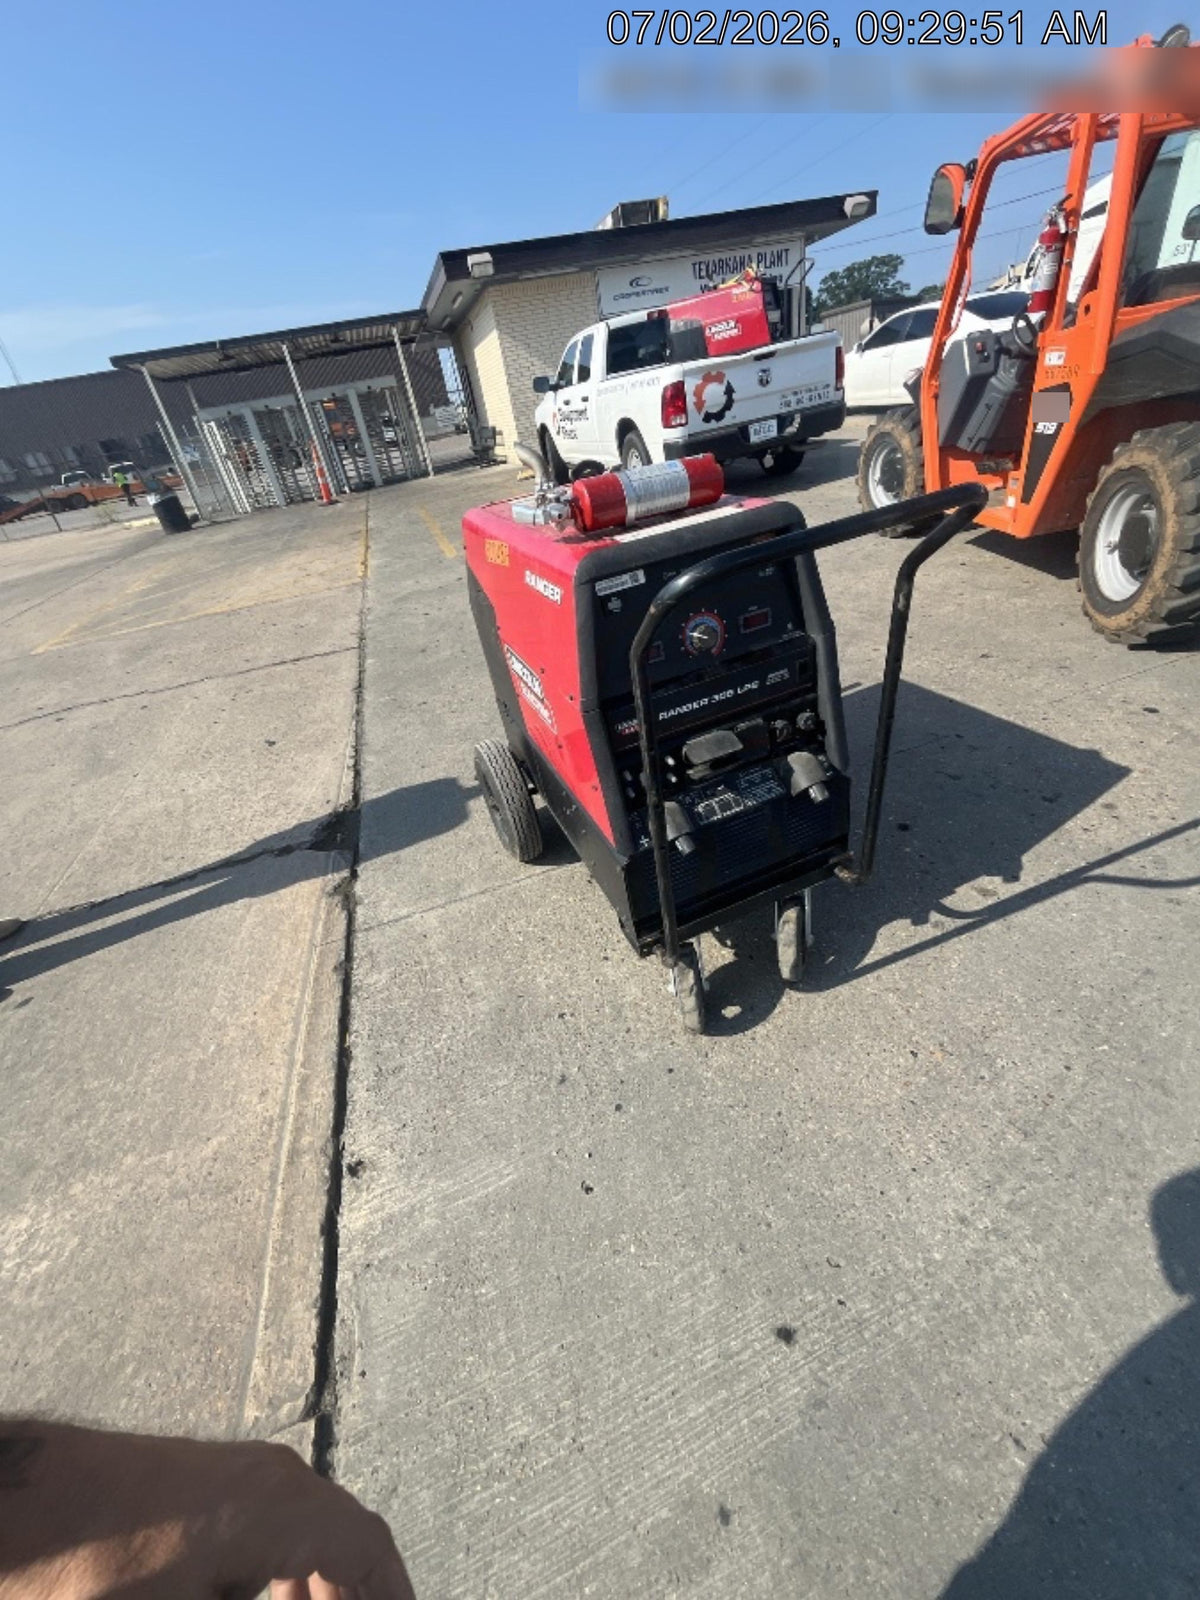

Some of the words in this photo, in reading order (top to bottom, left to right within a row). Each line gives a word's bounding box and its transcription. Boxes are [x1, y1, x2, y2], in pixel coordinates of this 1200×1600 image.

[691, 253, 754, 281] TEXARKANA
[756, 248, 791, 270] PLANT
[524, 570, 562, 605] RANGER
[658, 697, 710, 721] RANGER
